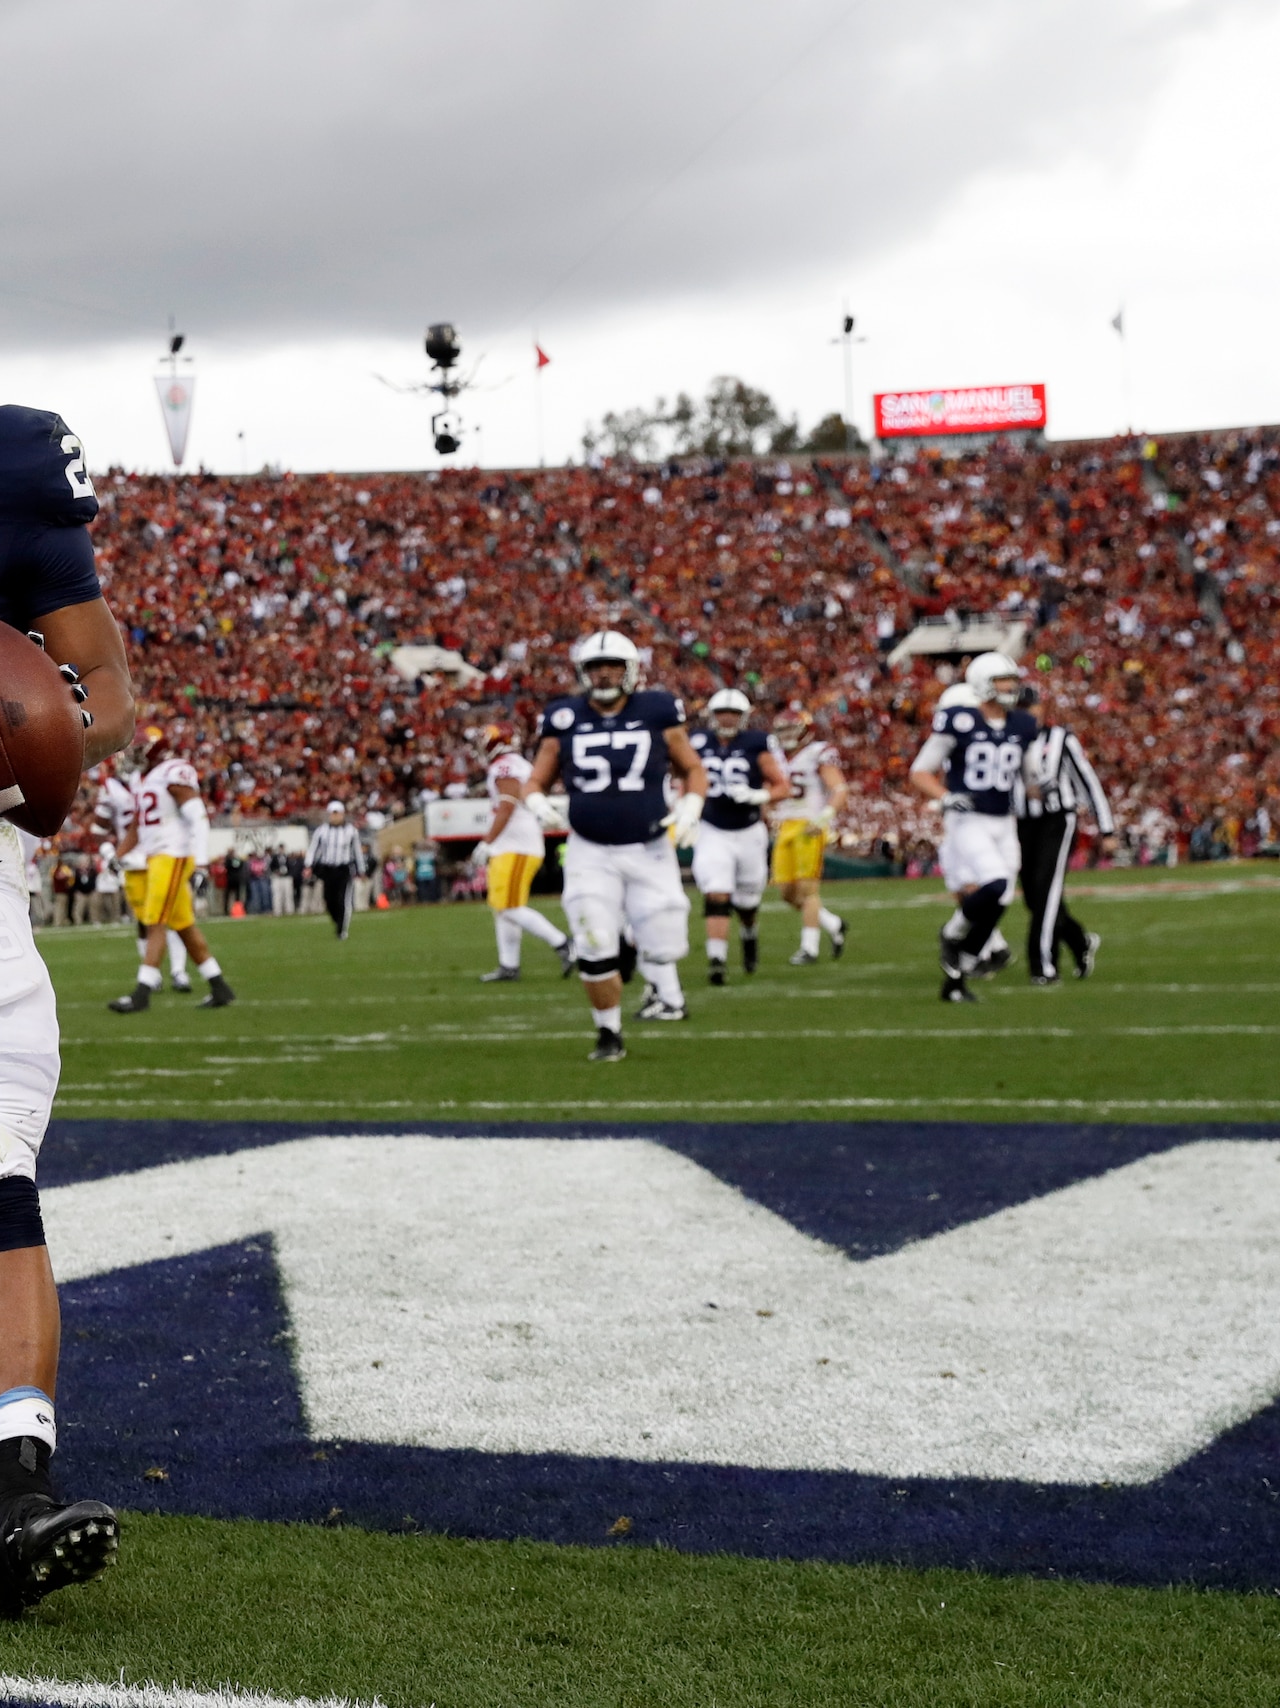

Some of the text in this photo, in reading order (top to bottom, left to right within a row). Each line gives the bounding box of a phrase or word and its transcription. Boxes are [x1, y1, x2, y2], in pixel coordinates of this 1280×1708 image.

[881, 393, 931, 417] SAN
[945, 386, 1042, 412] MANUEL
[572, 730, 652, 793] 57
[963, 741, 1022, 791] 88
